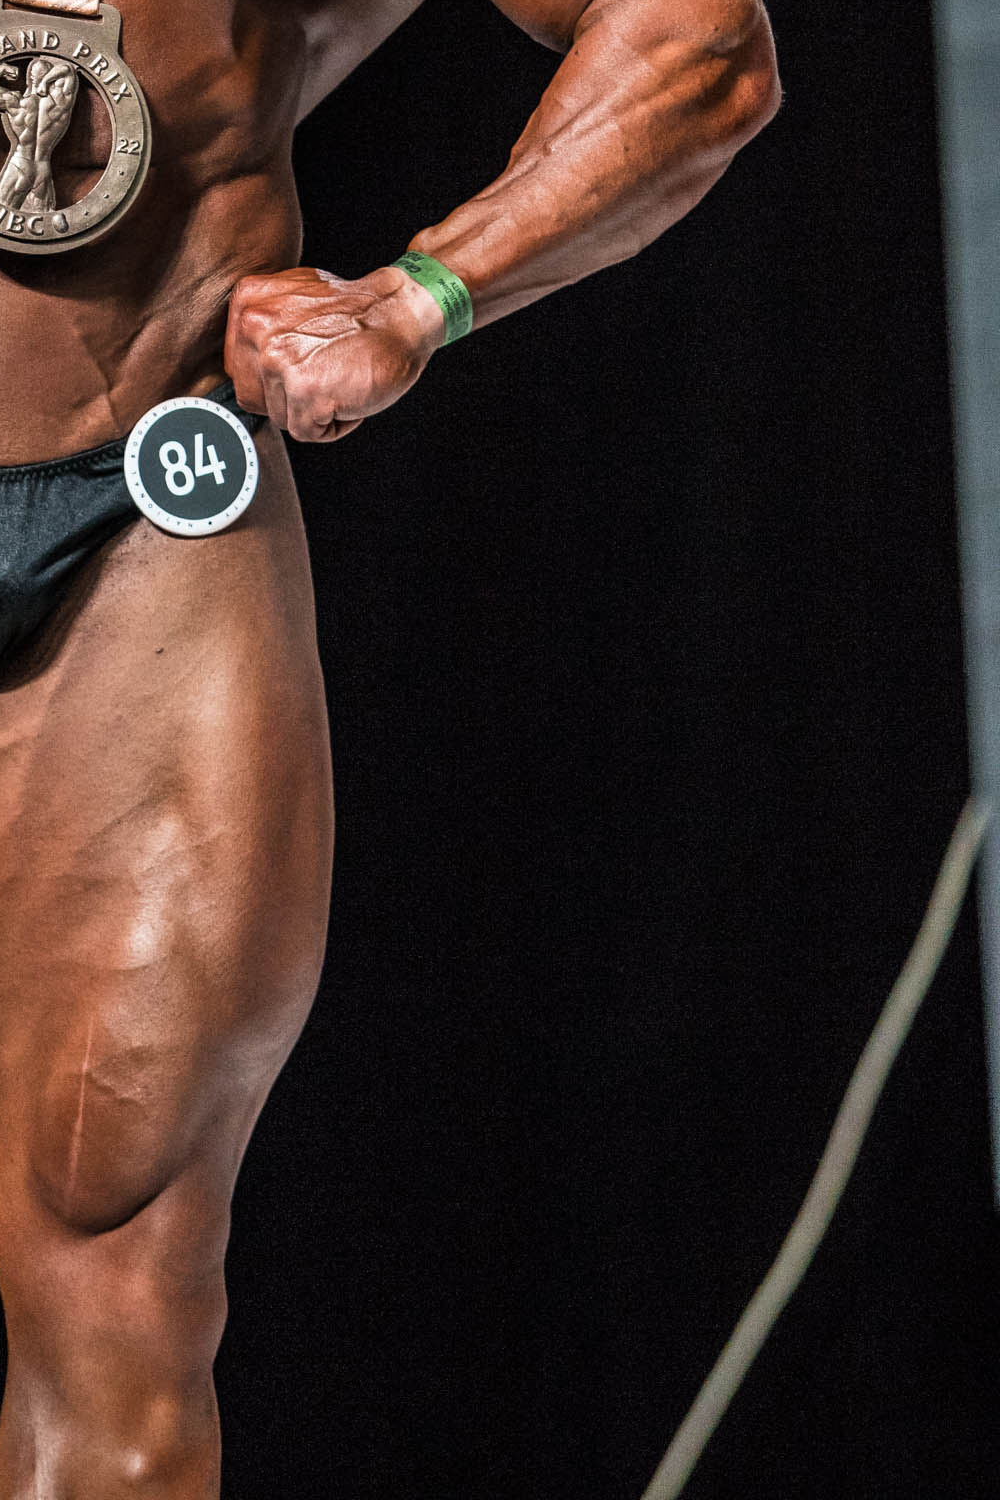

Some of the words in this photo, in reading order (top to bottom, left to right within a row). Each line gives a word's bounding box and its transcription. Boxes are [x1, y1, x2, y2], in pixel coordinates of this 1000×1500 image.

[72, 41, 133, 104] PRIX
[117, 138, 141, 155] 22
[159, 432, 226, 496] 84
